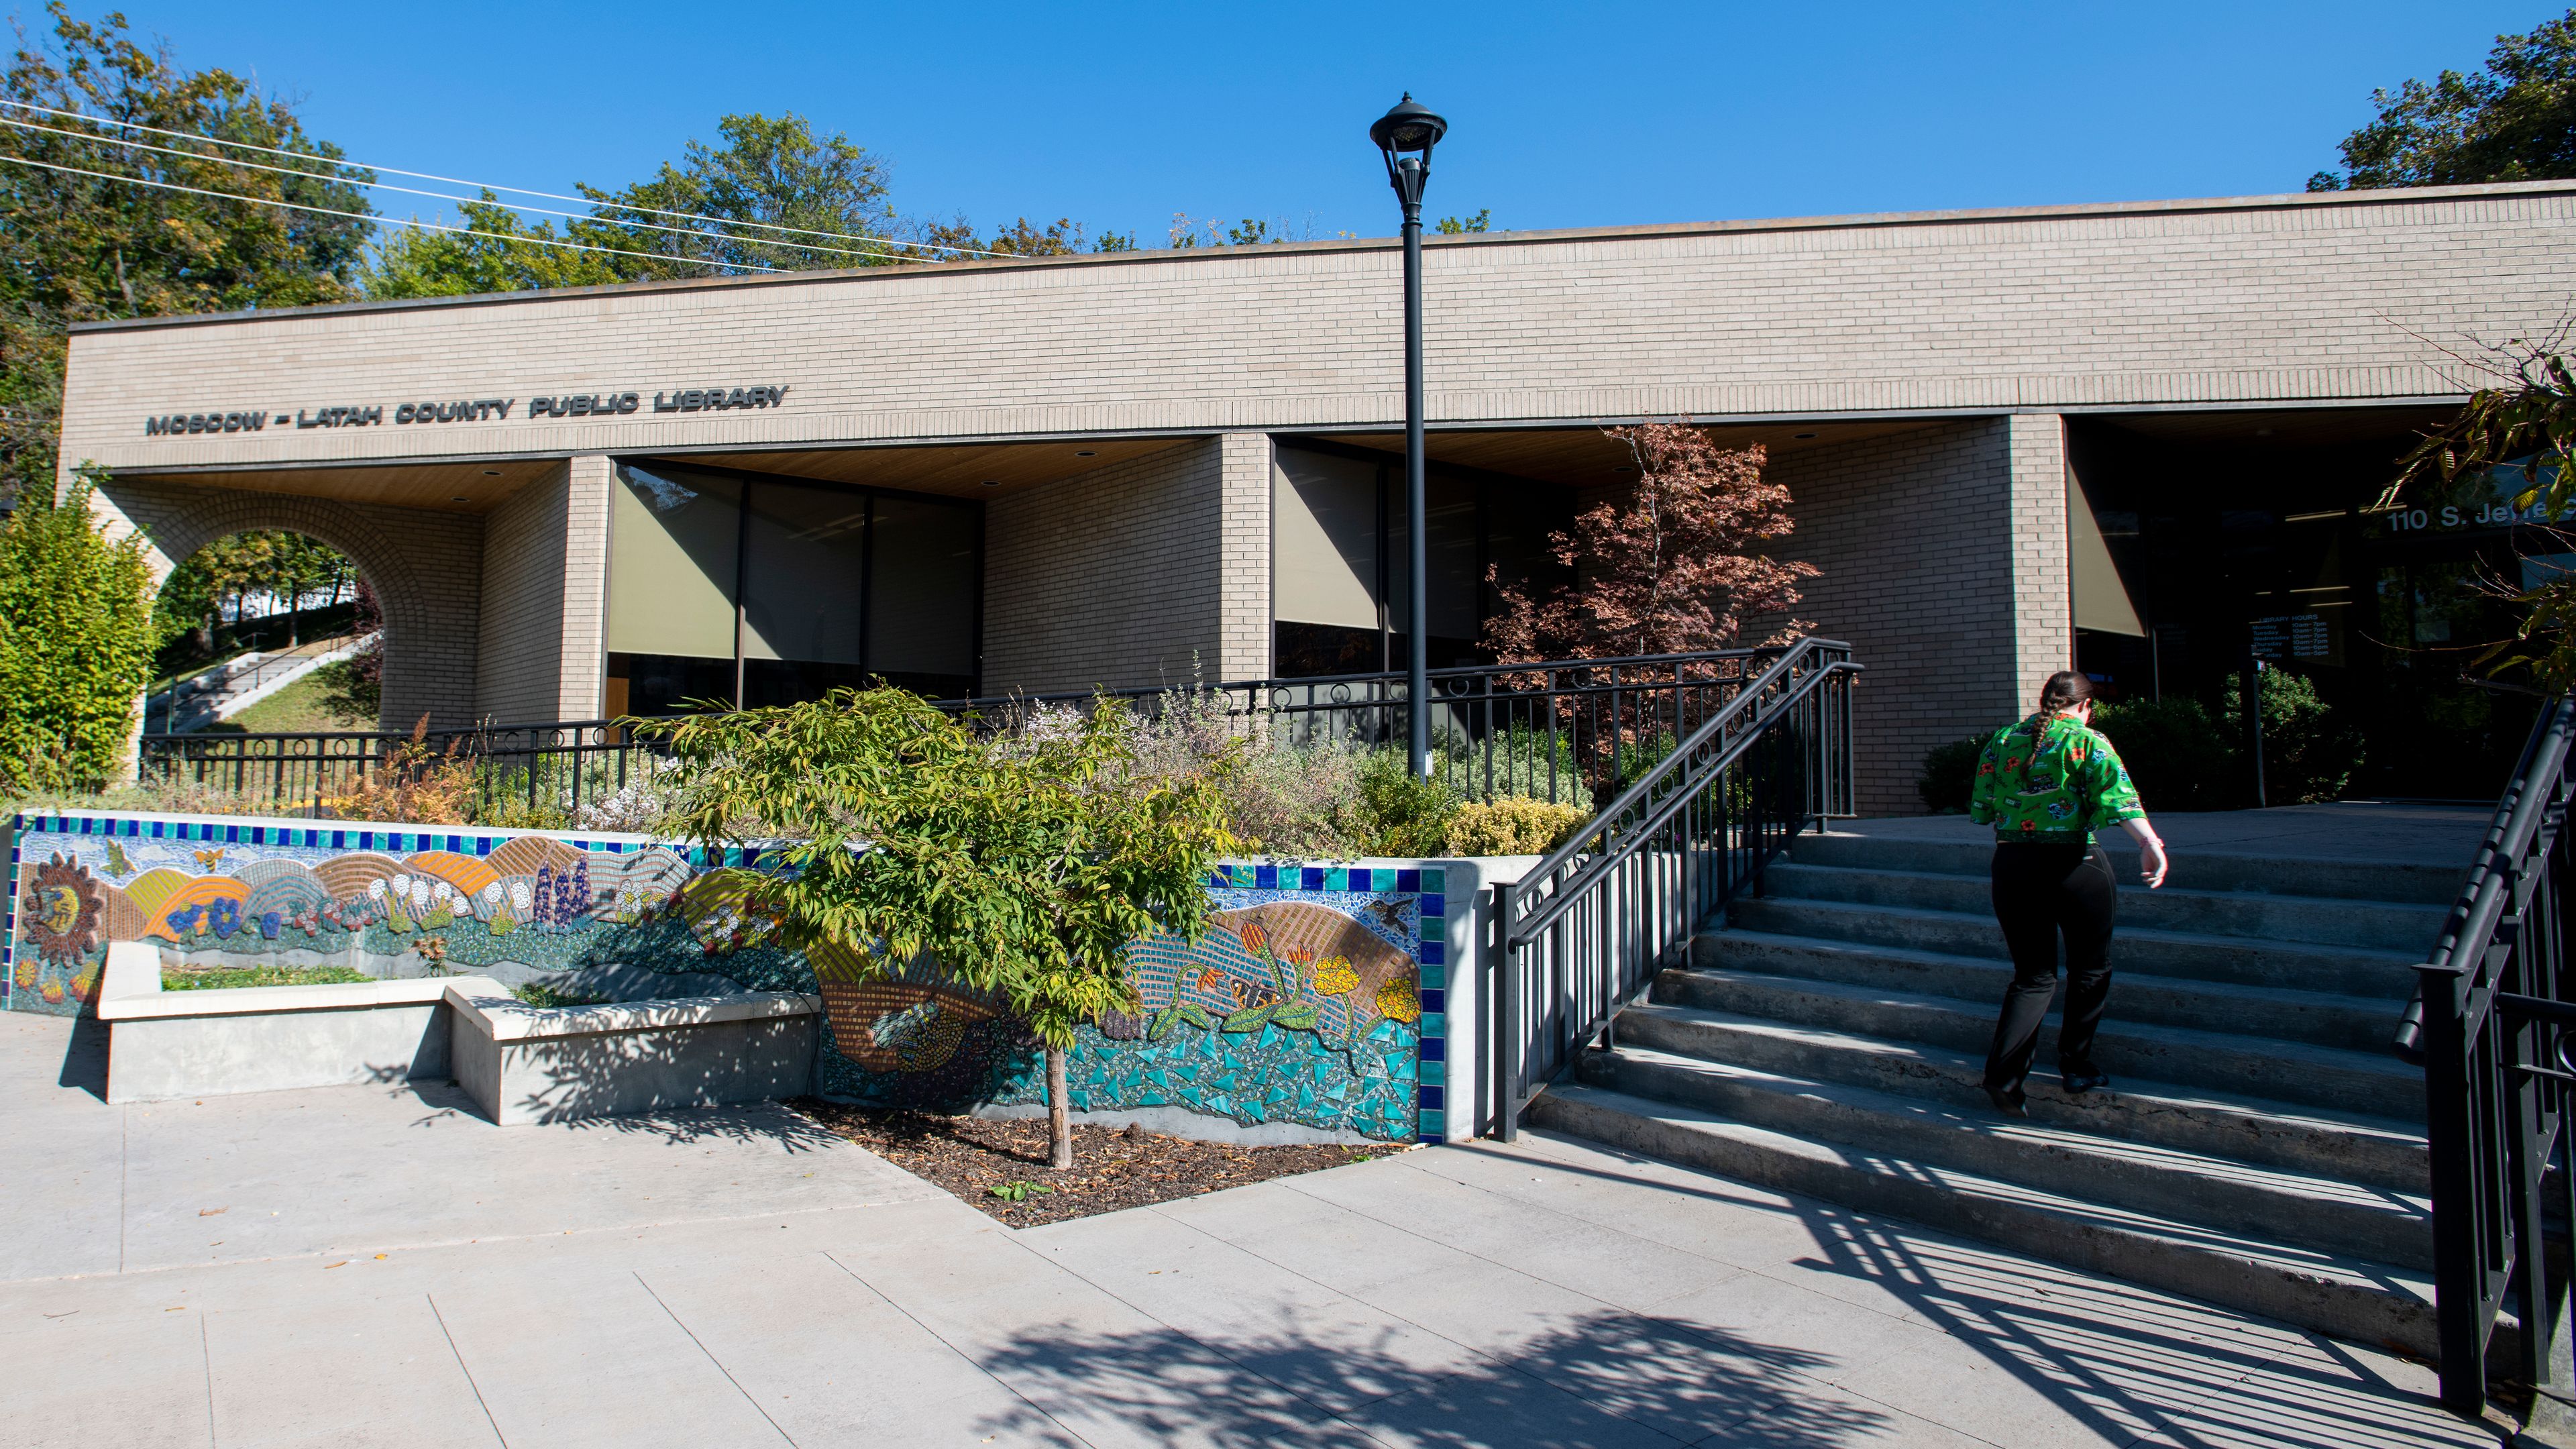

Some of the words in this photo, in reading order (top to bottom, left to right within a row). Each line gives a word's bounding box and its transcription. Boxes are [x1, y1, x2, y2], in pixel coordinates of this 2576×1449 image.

[147, 412, 267, 435] MOSCOW
[297, 405, 383, 429] LATAH
[396, 398, 515, 423] COUNTY
[529, 392, 639, 419] PUBLIC
[654, 384, 790, 413] LIBRARY
[2387, 508, 2428, 531] 110
[2440, 505, 2467, 527] S.
